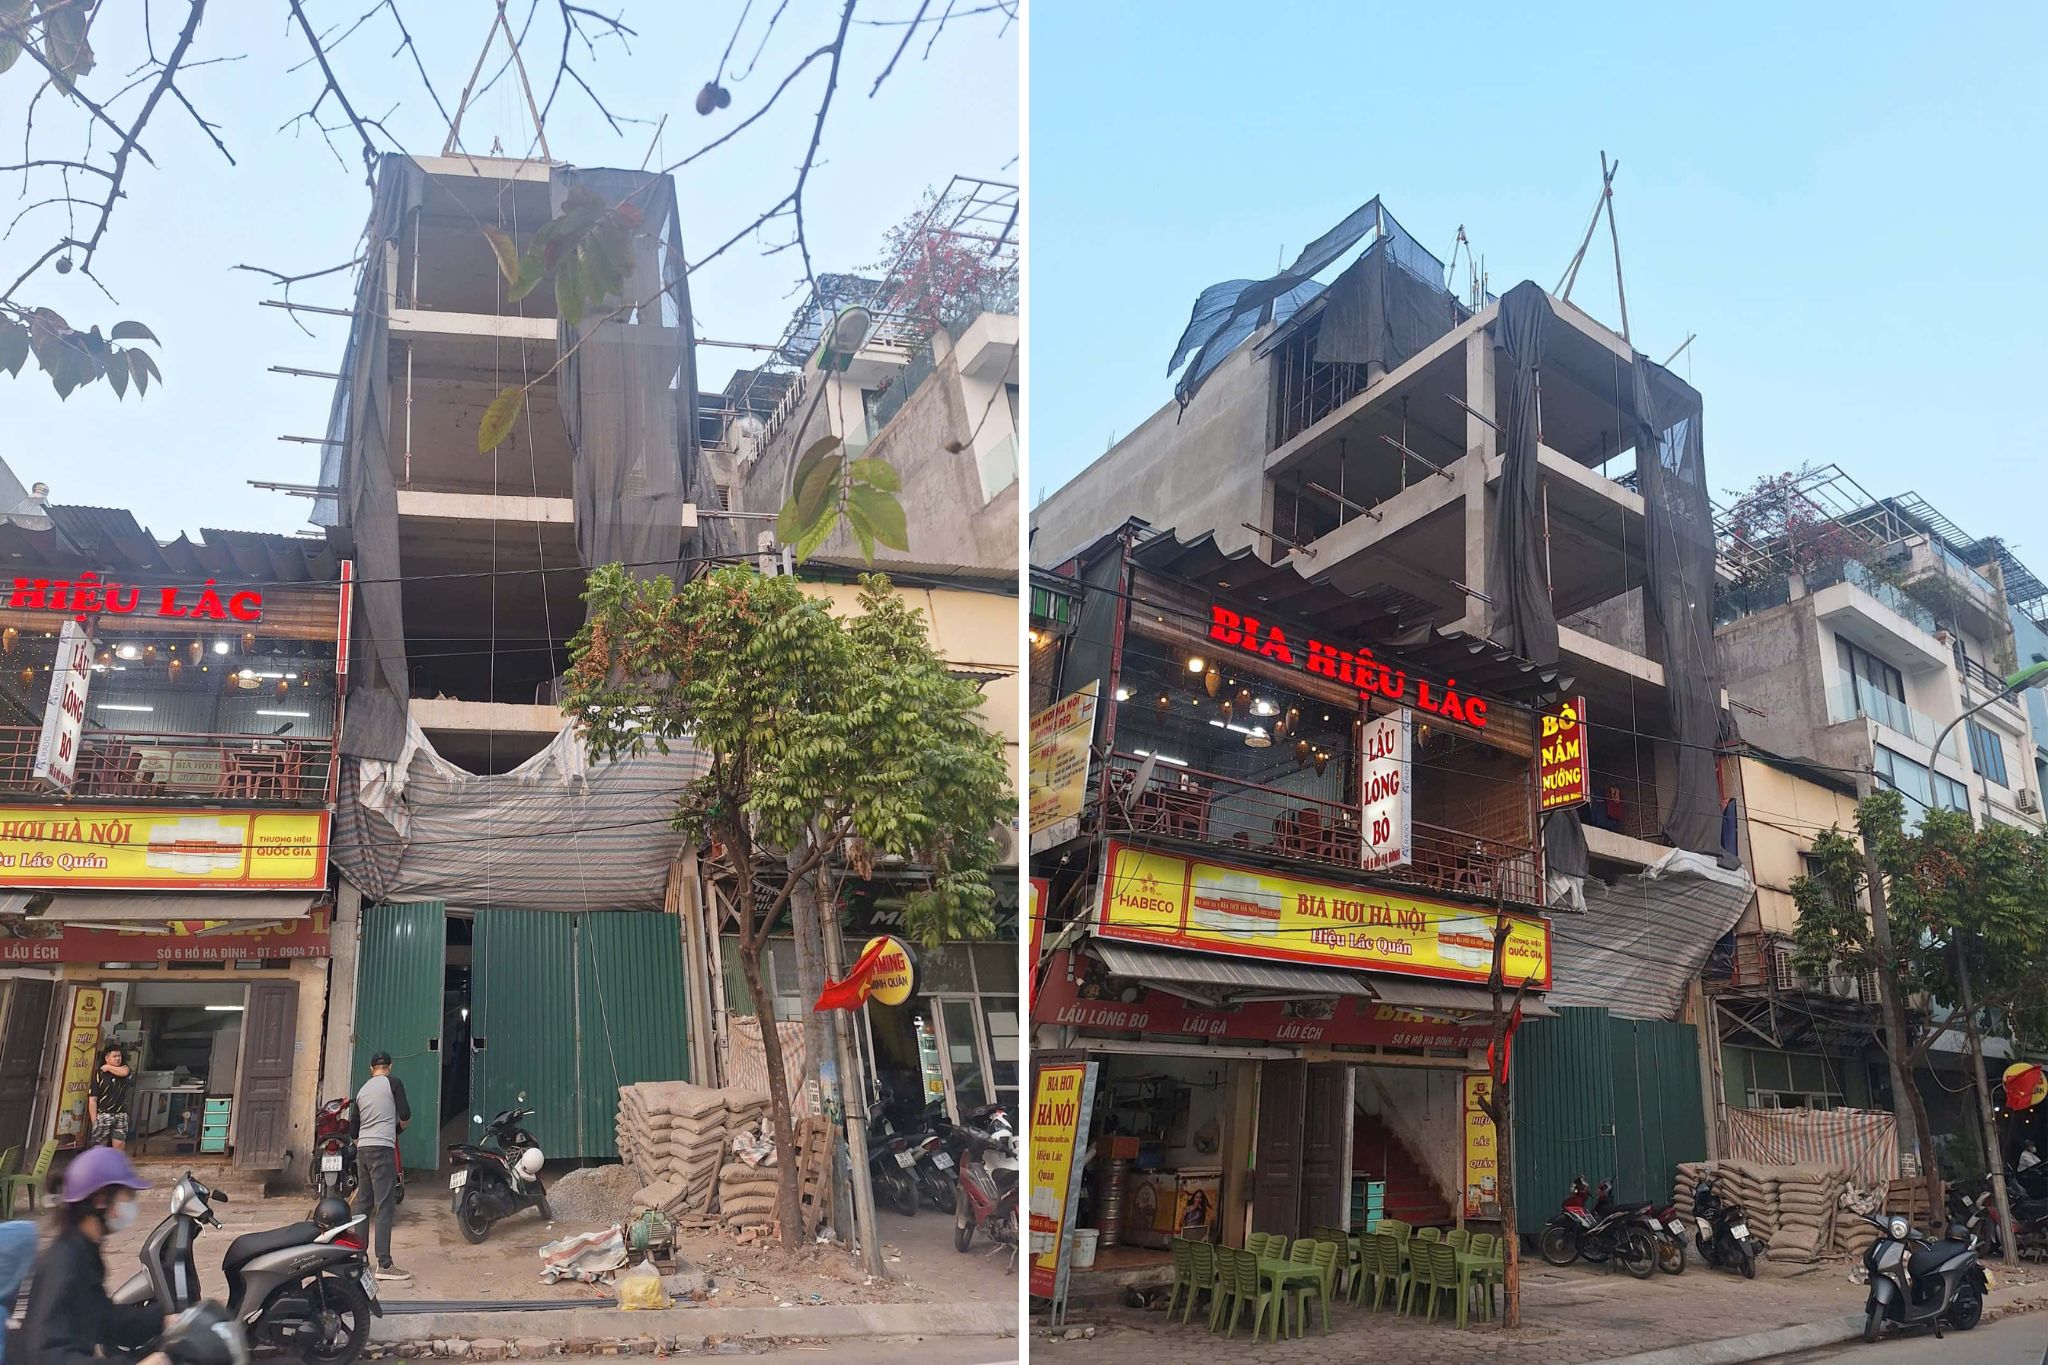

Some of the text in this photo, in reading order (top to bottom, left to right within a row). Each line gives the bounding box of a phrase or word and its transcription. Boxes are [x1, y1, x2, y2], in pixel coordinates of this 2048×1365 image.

[9, 571, 263, 622] HIỆU LÁC
[72, 640, 90, 680] LẨU
[1210, 604, 1487, 728] BIA HIỆU LÁC
[62, 681, 85, 724] LÒNG
[1542, 703, 1577, 737] BÒ
[59, 730, 72, 763] BÒ
[1368, 721, 1395, 762] LẨU
[1541, 735, 1580, 767] NẦM
[1364, 770, 1400, 806] LÒNG
[1543, 767, 1581, 792] NƯỚNG
[1, 820, 46, 842] HƠI
[51, 816, 82, 842] HÀ
[89, 818, 133, 849] NỘI
[1372, 811, 1391, 846] BÒ
[20, 852, 54, 868] Lác
[58, 853, 108, 871] Quán
[292, 847, 311, 856] GIA
[1119, 893, 1174, 913] HABECO
[1297, 893, 1427, 936] BIA HƠI HÀ NỘI
[4, 941, 59, 960] LẨU ẾCH
[157, 945, 172, 959] SỐ
[175, 948, 182, 959] 6
[203, 948, 218, 961] HẠ
[220, 945, 247, 959] ĐÌNH
[280, 946, 306, 957] 0904
[308, 946, 327, 956] 711
[1310, 929, 1413, 956] Hiệu Lác Quán
[1508, 945, 1543, 959] QUỐC GIA
[872, 953, 906, 974] AMING
[1057, 1002, 1087, 1024] LẨU
[1088, 1006, 1127, 1027] LÒNG
[1301, 1022, 1324, 1040] ẾCH
[1047, 1075, 1074, 1091] BIA HƠI
[1036, 1098, 1075, 1132] HÀ NỘI
[1473, 1135, 1490, 1147] LÁC
[1469, 1156, 1496, 1168] QUÁN
